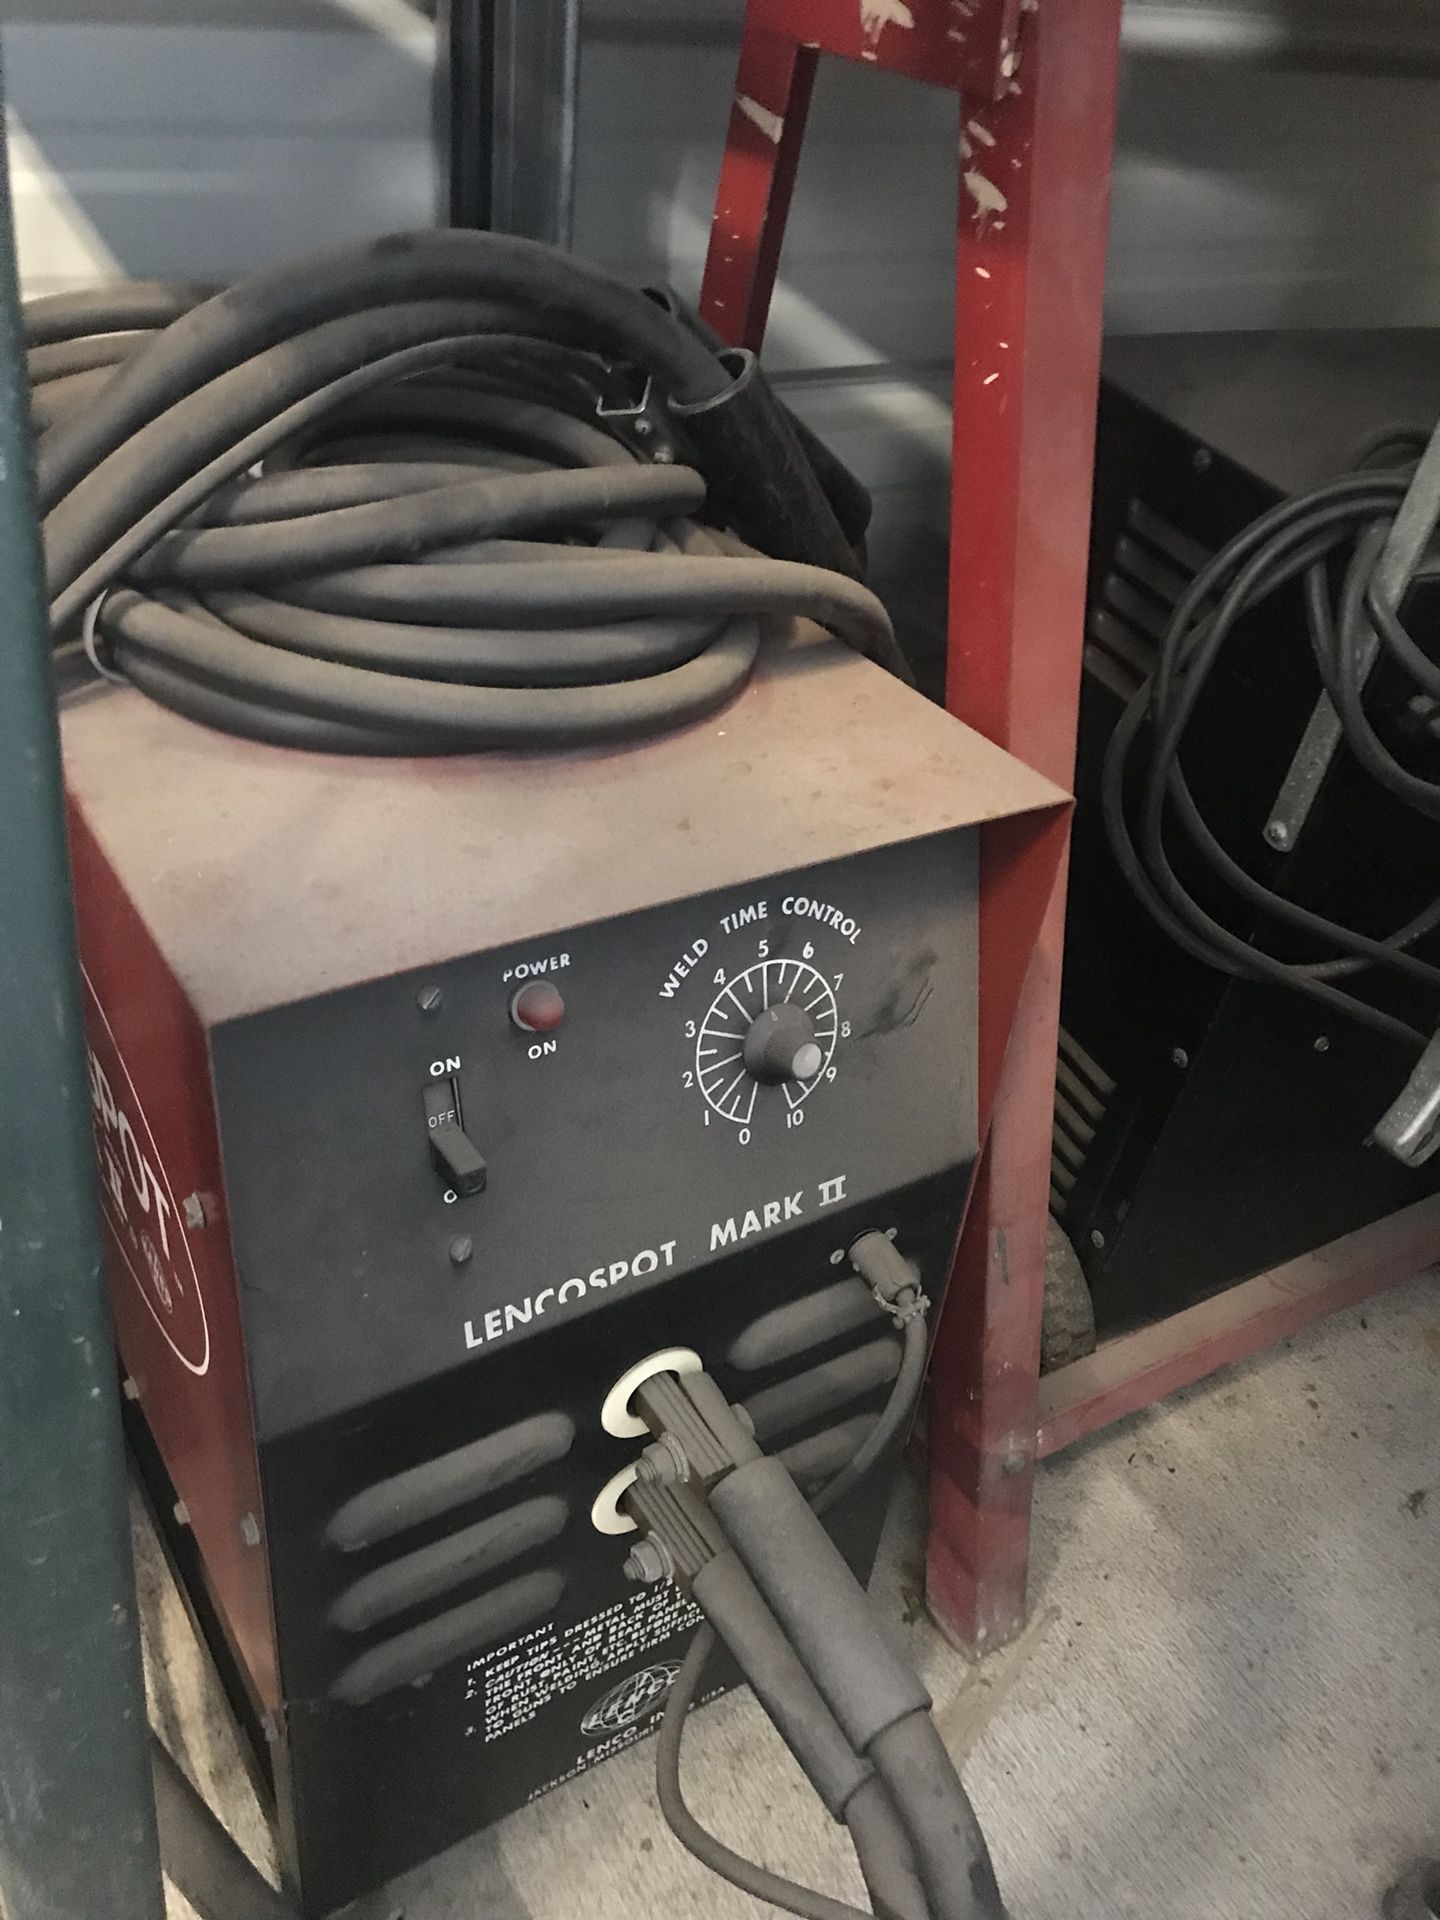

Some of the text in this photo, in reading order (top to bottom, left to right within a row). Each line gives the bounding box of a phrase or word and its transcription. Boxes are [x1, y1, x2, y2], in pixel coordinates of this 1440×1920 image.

[659, 897, 862, 999] WELD TIME CONTROL
[758, 939, 769, 958] 5
[802, 942, 814, 959] 6
[503, 953, 571, 982] POWER
[713, 968, 726, 985] 4
[833, 973, 844, 991] 7
[685, 1020, 696, 1038] 3
[841, 1020, 851, 1038] 8
[528, 1040, 557, 1059] ON
[429, 1055, 461, 1076] ON
[826, 1066, 837, 1083] 9
[682, 1071, 694, 1088] 2
[428, 1110, 455, 1128] OFF
[704, 1110, 710, 1126] 1
[786, 1109, 804, 1128] 10
[738, 1128, 751, 1145] 0
[463, 1175, 847, 1349] LENCOSPOT MARK II
[634, 1590, 669, 1613] MUST
[486, 1656, 519, 1677] KEEP
[527, 1637, 557, 1656] TIPS
[565, 1604, 622, 1637] DRESSED
[629, 1592, 646, 1604] TO
[468, 1623, 553, 1671] IMPORTANT
[487, 1679, 510, 1696] THE
[517, 1653, 562, 1681] FRONT
[572, 1634, 601, 1653] AND
[609, 1611, 643, 1634] BACK
[652, 1599, 668, 1611] OF
[485, 1678, 531, 1706] FRONT
[540, 1655, 576, 1678] ONLY
[585, 1642, 601, 1655] OF
[609, 1622, 641, 1643] REAR
[486, 1697, 528, 1723] WHEN
[607, 1636, 647, 1661] APPLY
[655, 1608, 700, 1636] SUFFICI
[486, 1720, 504, 1732] TO
[560, 1681, 576, 1693] TO
[486, 1701, 503, 1714] OF
[485, 1711, 535, 1742] PANELS
[577, 1712, 664, 1764] LENCO IN
